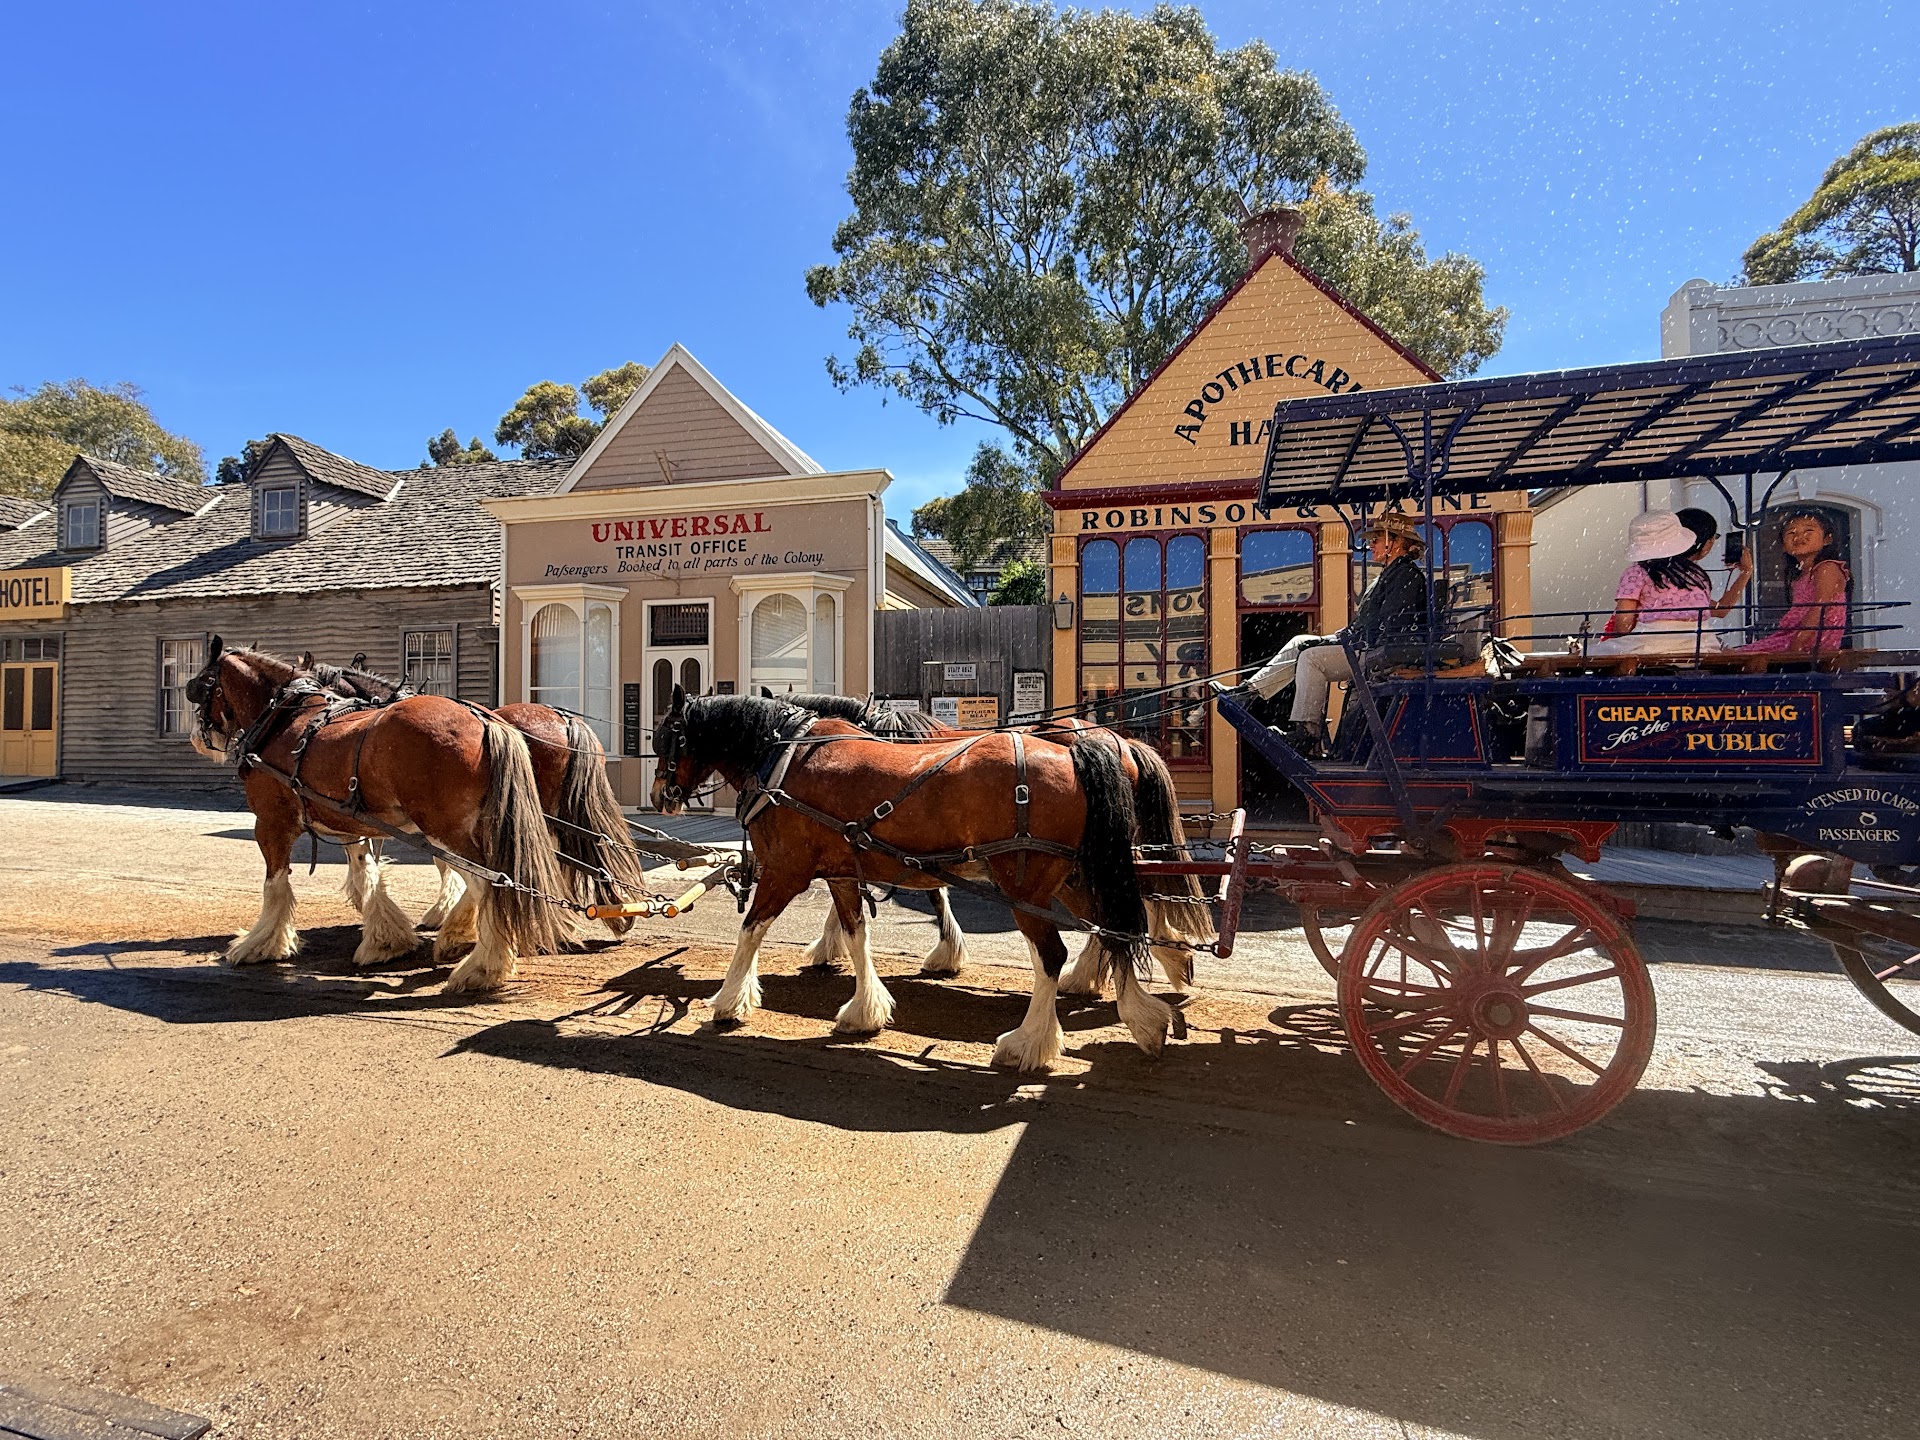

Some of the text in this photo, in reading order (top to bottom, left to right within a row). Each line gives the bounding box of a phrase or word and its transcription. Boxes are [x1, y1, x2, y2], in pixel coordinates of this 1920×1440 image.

[1174, 354, 1363, 445] APOTHECAR
[1229, 420, 1273, 446] HA
[592, 512, 771, 543] UNIVERSAL
[1081, 503, 1271, 530] ROBINSON
[1296, 505, 1320, 518] &
[615, 539, 747, 559] TRANSIT OFFICE
[617, 559, 662, 573] Booked
[668, 559, 679, 570] to
[684, 557, 700, 569] all
[704, 556, 738, 571] parts
[744, 554, 758, 566] of
[761, 553, 778, 565] the
[784, 551, 825, 566] Colony.
[0, 577, 59, 607] HOTEL.
[1597, 704, 1798, 722] CHEAP TRAVELLING
[1602, 720, 1670, 750] for the
[1686, 733, 1786, 751] PUBLIC
[1863, 788, 1880, 801] TO
[1819, 828, 1900, 842] PASSENGERS
